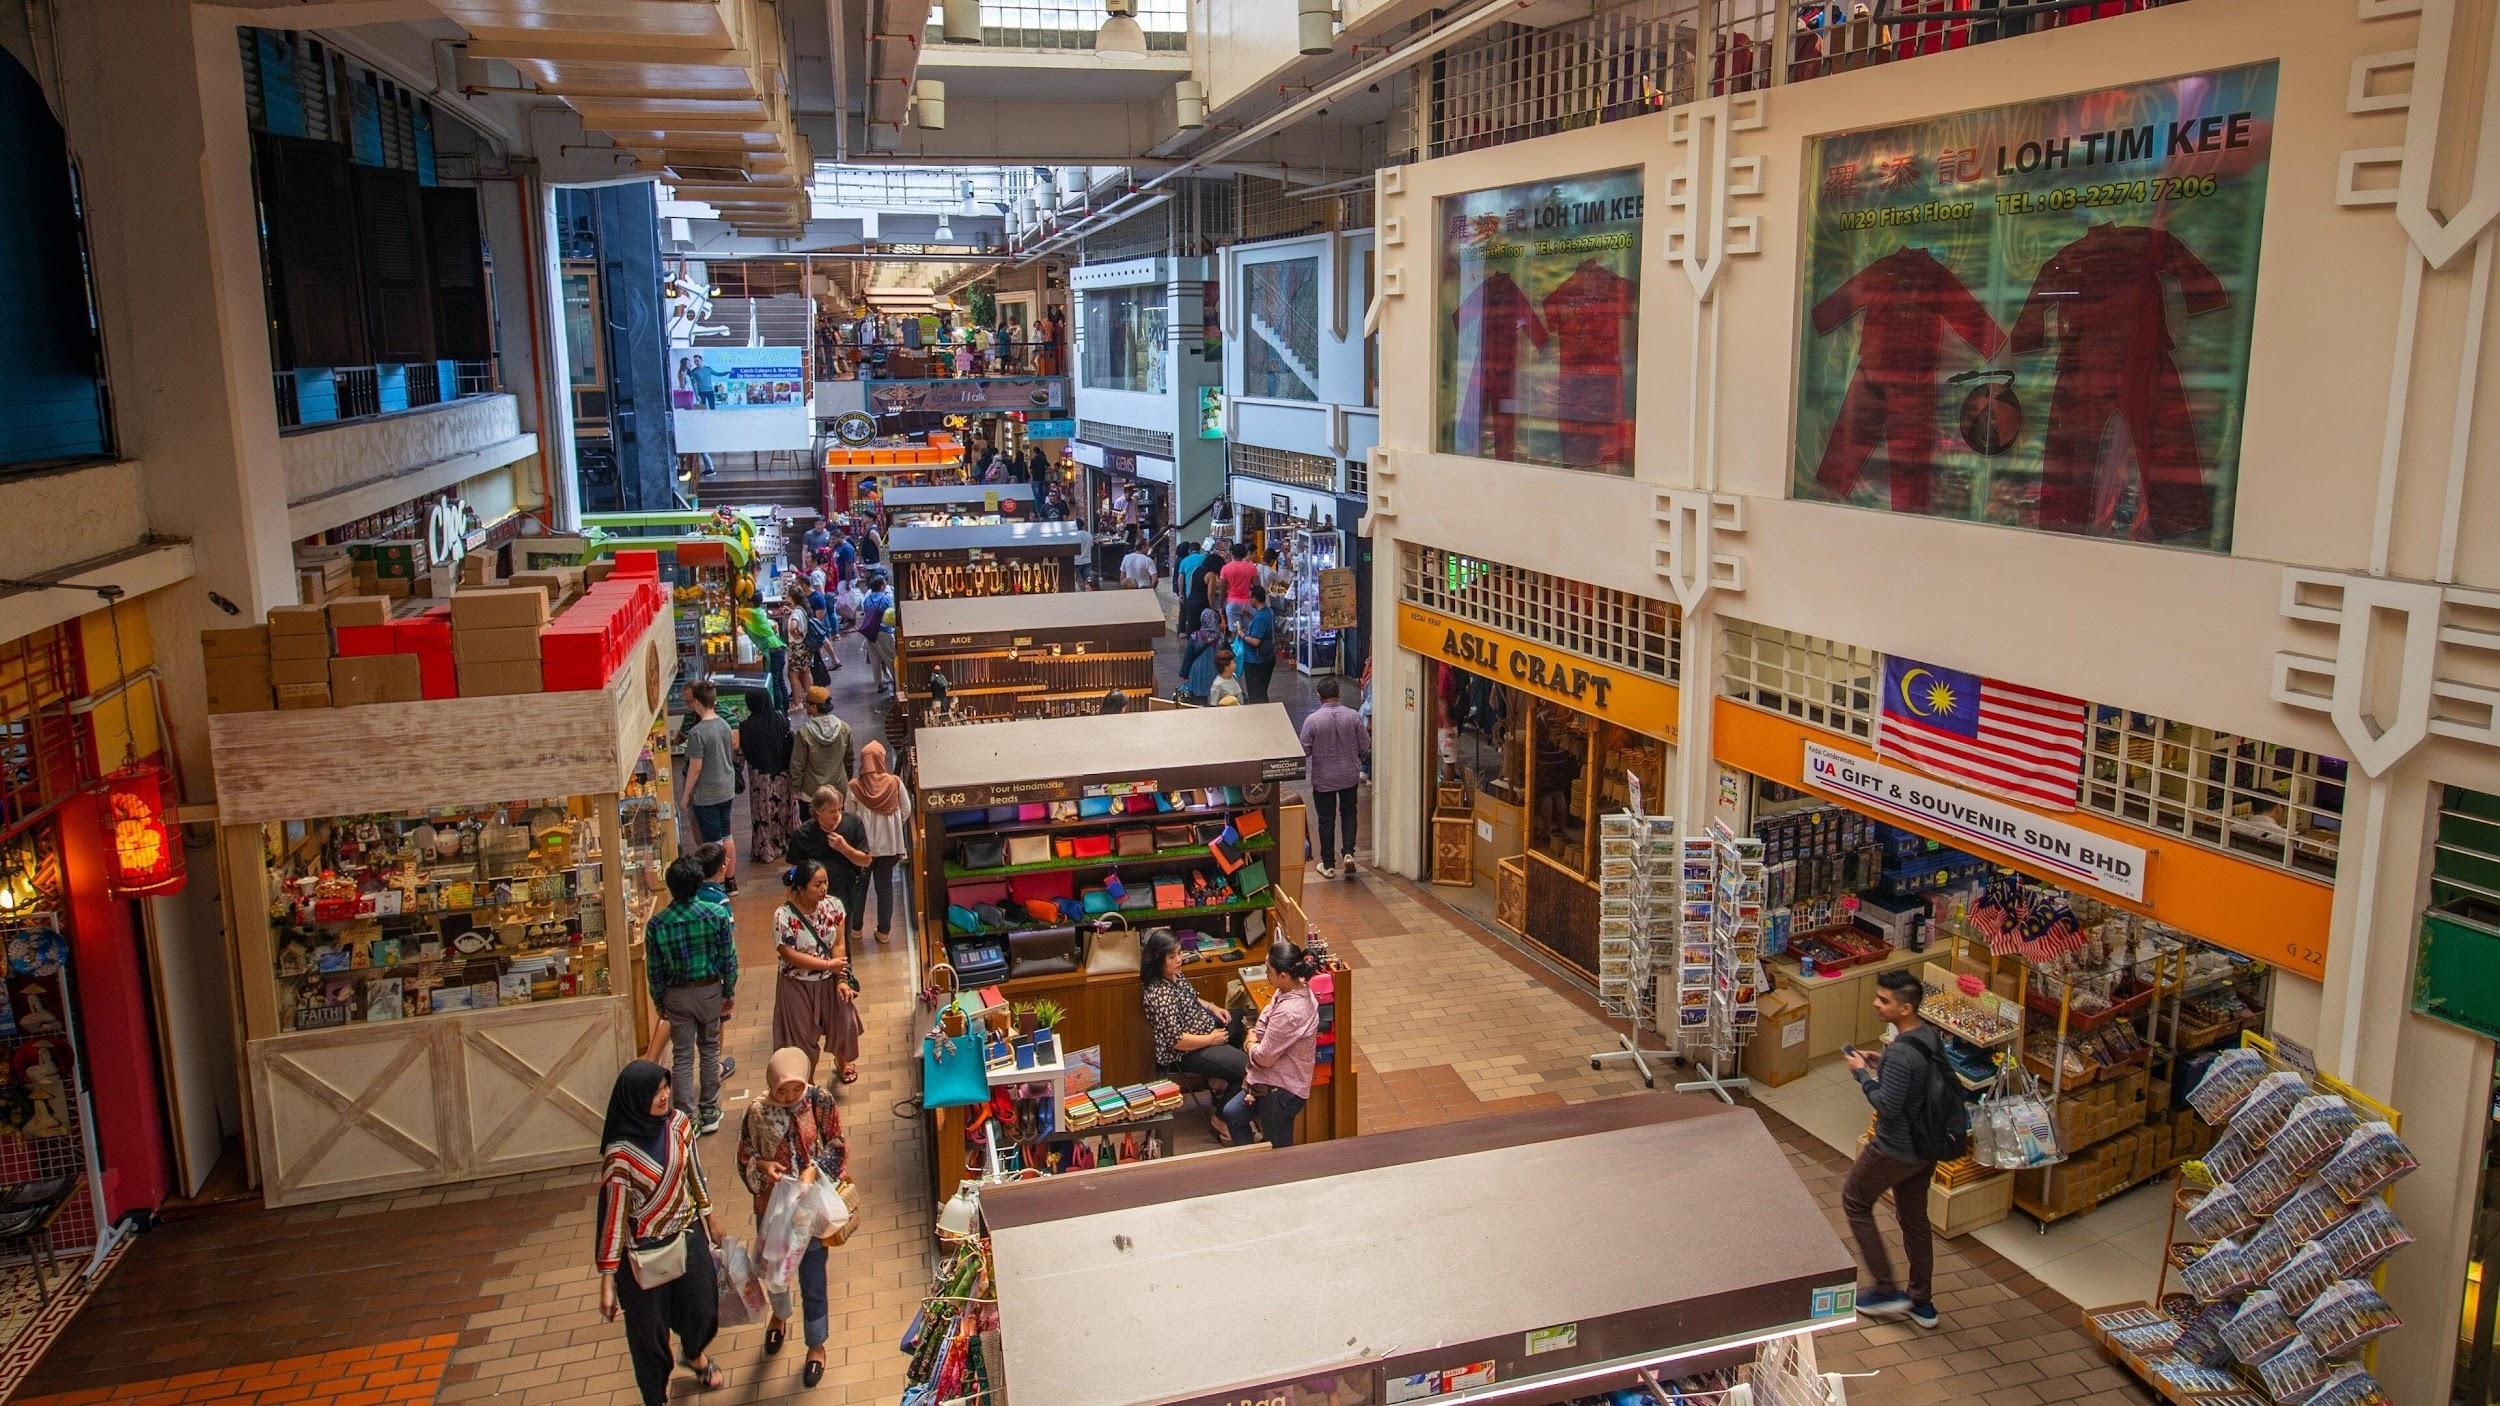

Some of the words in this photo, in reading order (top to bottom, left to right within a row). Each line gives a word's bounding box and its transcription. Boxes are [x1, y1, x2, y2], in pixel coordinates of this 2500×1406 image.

[1995, 136, 2072, 178] LOH
[2079, 123, 2155, 167] TIM
[2165, 110, 2253, 157] KEE
[2048, 180, 2146, 212] 03-2274
[2151, 173, 2219, 203] 7206
[1534, 206, 1569, 230] LOH
[1572, 199, 1606, 226] TIM
[1839, 209, 1878, 232] M29
[1880, 204, 1921, 228] First
[1923, 199, 1974, 223] Floor
[1500, 242, 1526, 258] Floor
[1604, 232, 1634, 251] 7206
[1115, 454, 1135, 473] GEMS
[909, 639, 935, 648] CK-05
[950, 636, 972, 645] AKOE
[1442, 628, 1499, 671] ASLI
[1509, 650, 1612, 709] CRAFT
[1270, 761, 1298, 770] WELCOME
[927, 792, 966, 806] CK-03
[990, 785, 1011, 795] Your
[1012, 780, 1065, 793] Handmade
[989, 794, 1019, 805] Beads
[1813, 758, 1836, 777] UA
[1842, 768, 1883, 792] GIFT
[1889, 784, 1902, 800] &
[1909, 790, 2016, 840] SOUVENIR
[2023, 829, 2071, 858] SDN
[2079, 847, 2132, 878] BHD
[2287, 943, 2297, 959] G
[2302, 948, 2322, 965] 22
